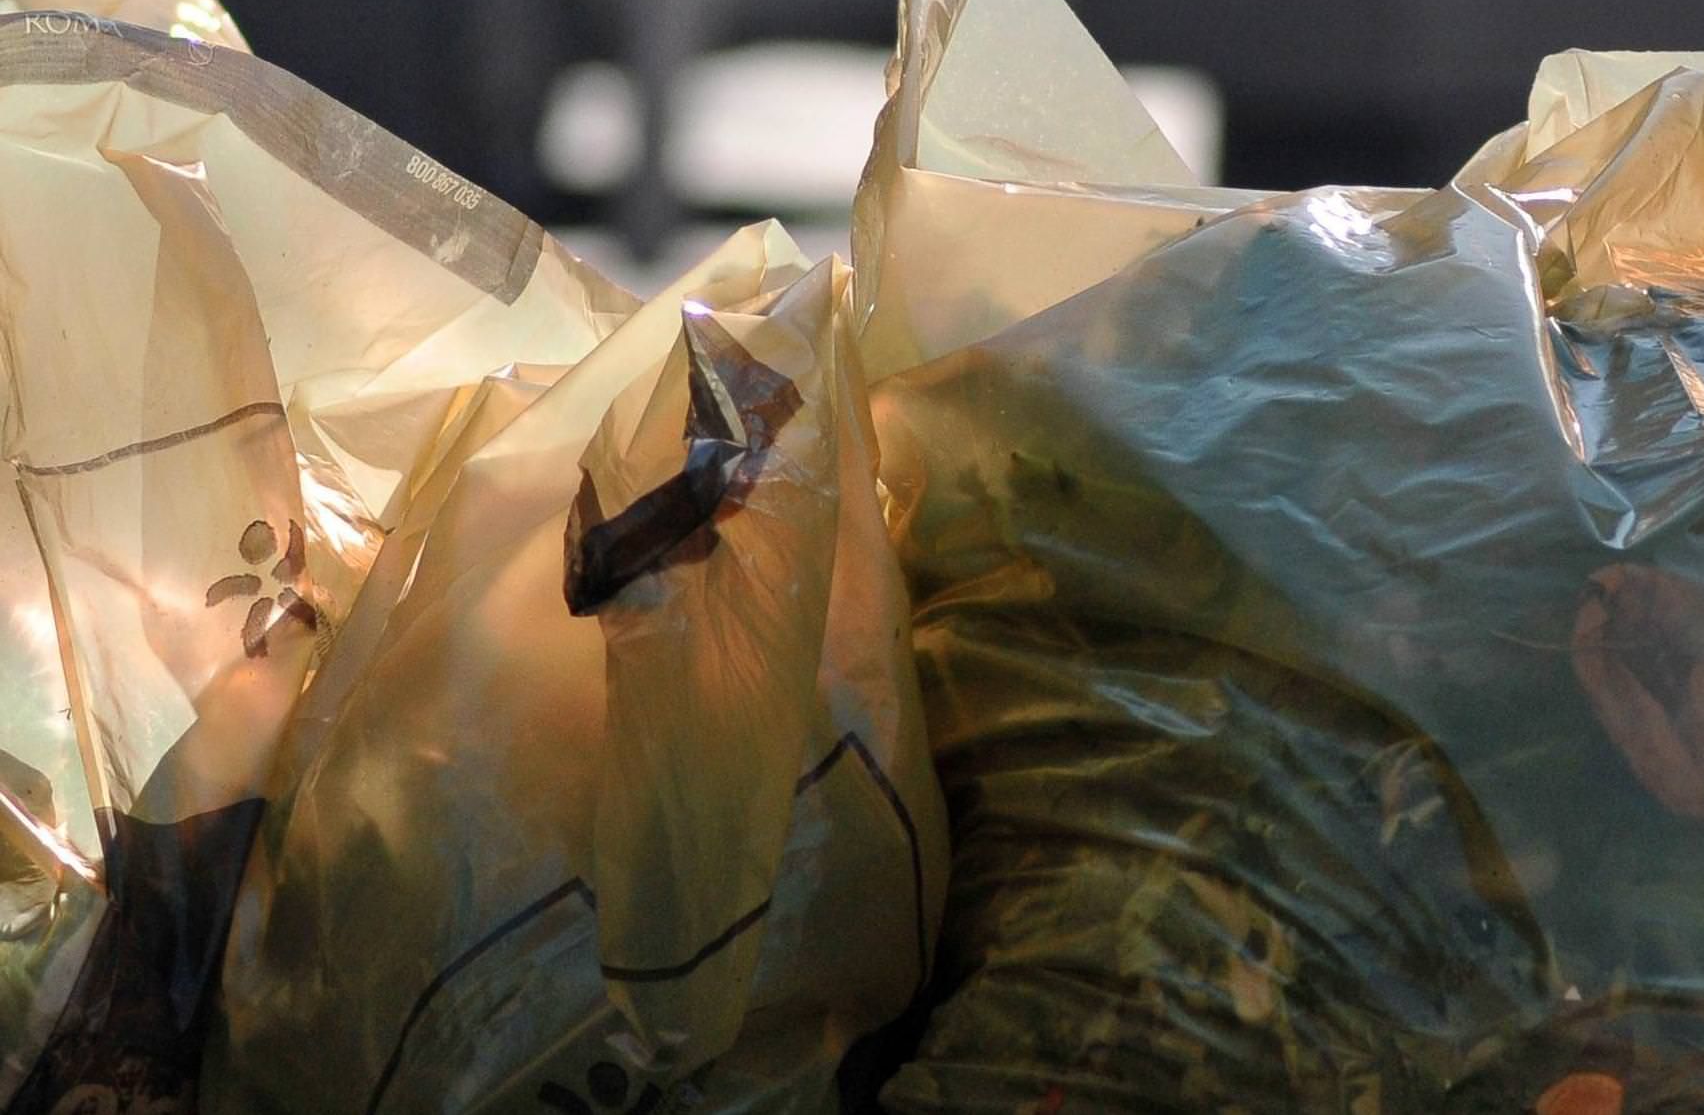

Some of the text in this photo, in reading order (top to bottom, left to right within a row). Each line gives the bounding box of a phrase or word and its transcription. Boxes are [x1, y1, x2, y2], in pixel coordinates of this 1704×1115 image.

[25, 13, 124, 39] ROMA
[406, 155, 437, 183] 800
[454, 186, 481, 209] 035
